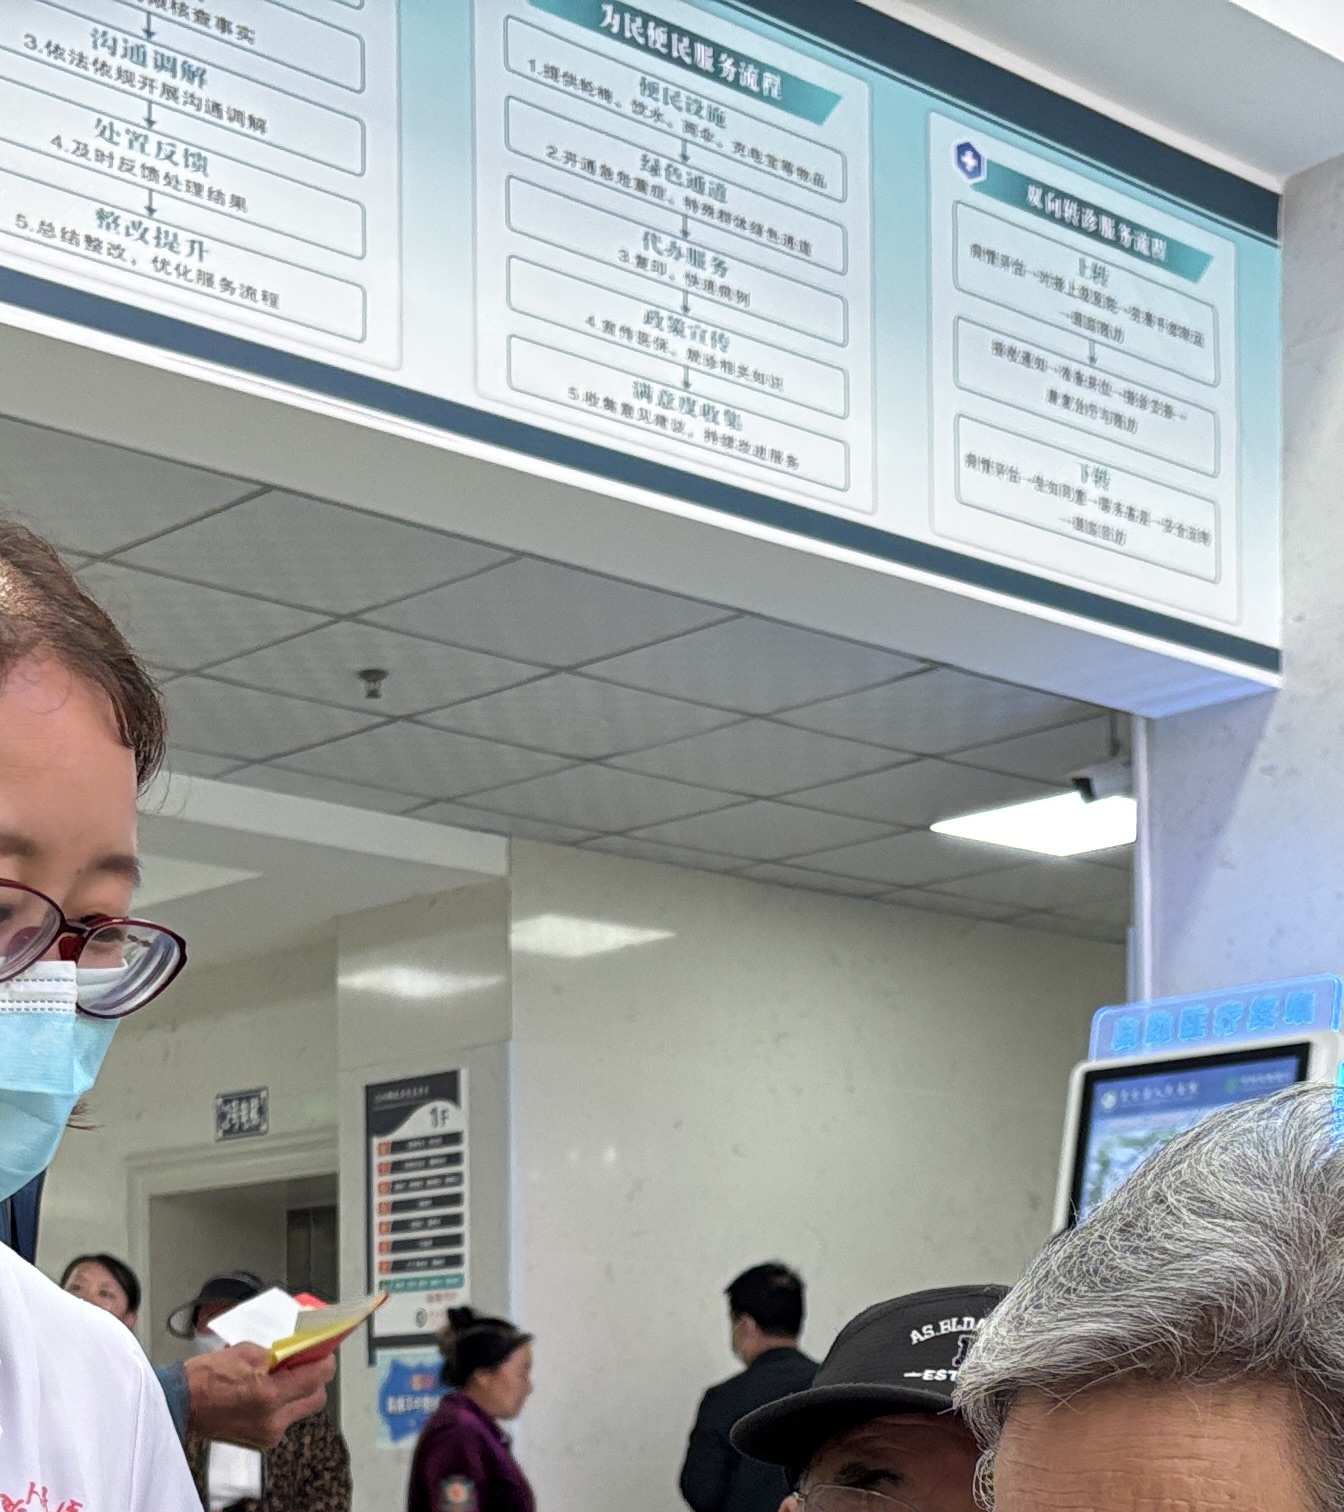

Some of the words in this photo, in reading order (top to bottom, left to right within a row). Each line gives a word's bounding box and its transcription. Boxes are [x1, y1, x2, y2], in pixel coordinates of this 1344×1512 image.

[90, 27, 208, 89] 沟通调解
[601, 3, 783, 101] 为民便民服务流程
[95, 118, 209, 177] 处置反馈
[640, 152, 728, 204] 绿色通道
[95, 207, 209, 263] 整改提升
[642, 231, 729, 280] 代办服务
